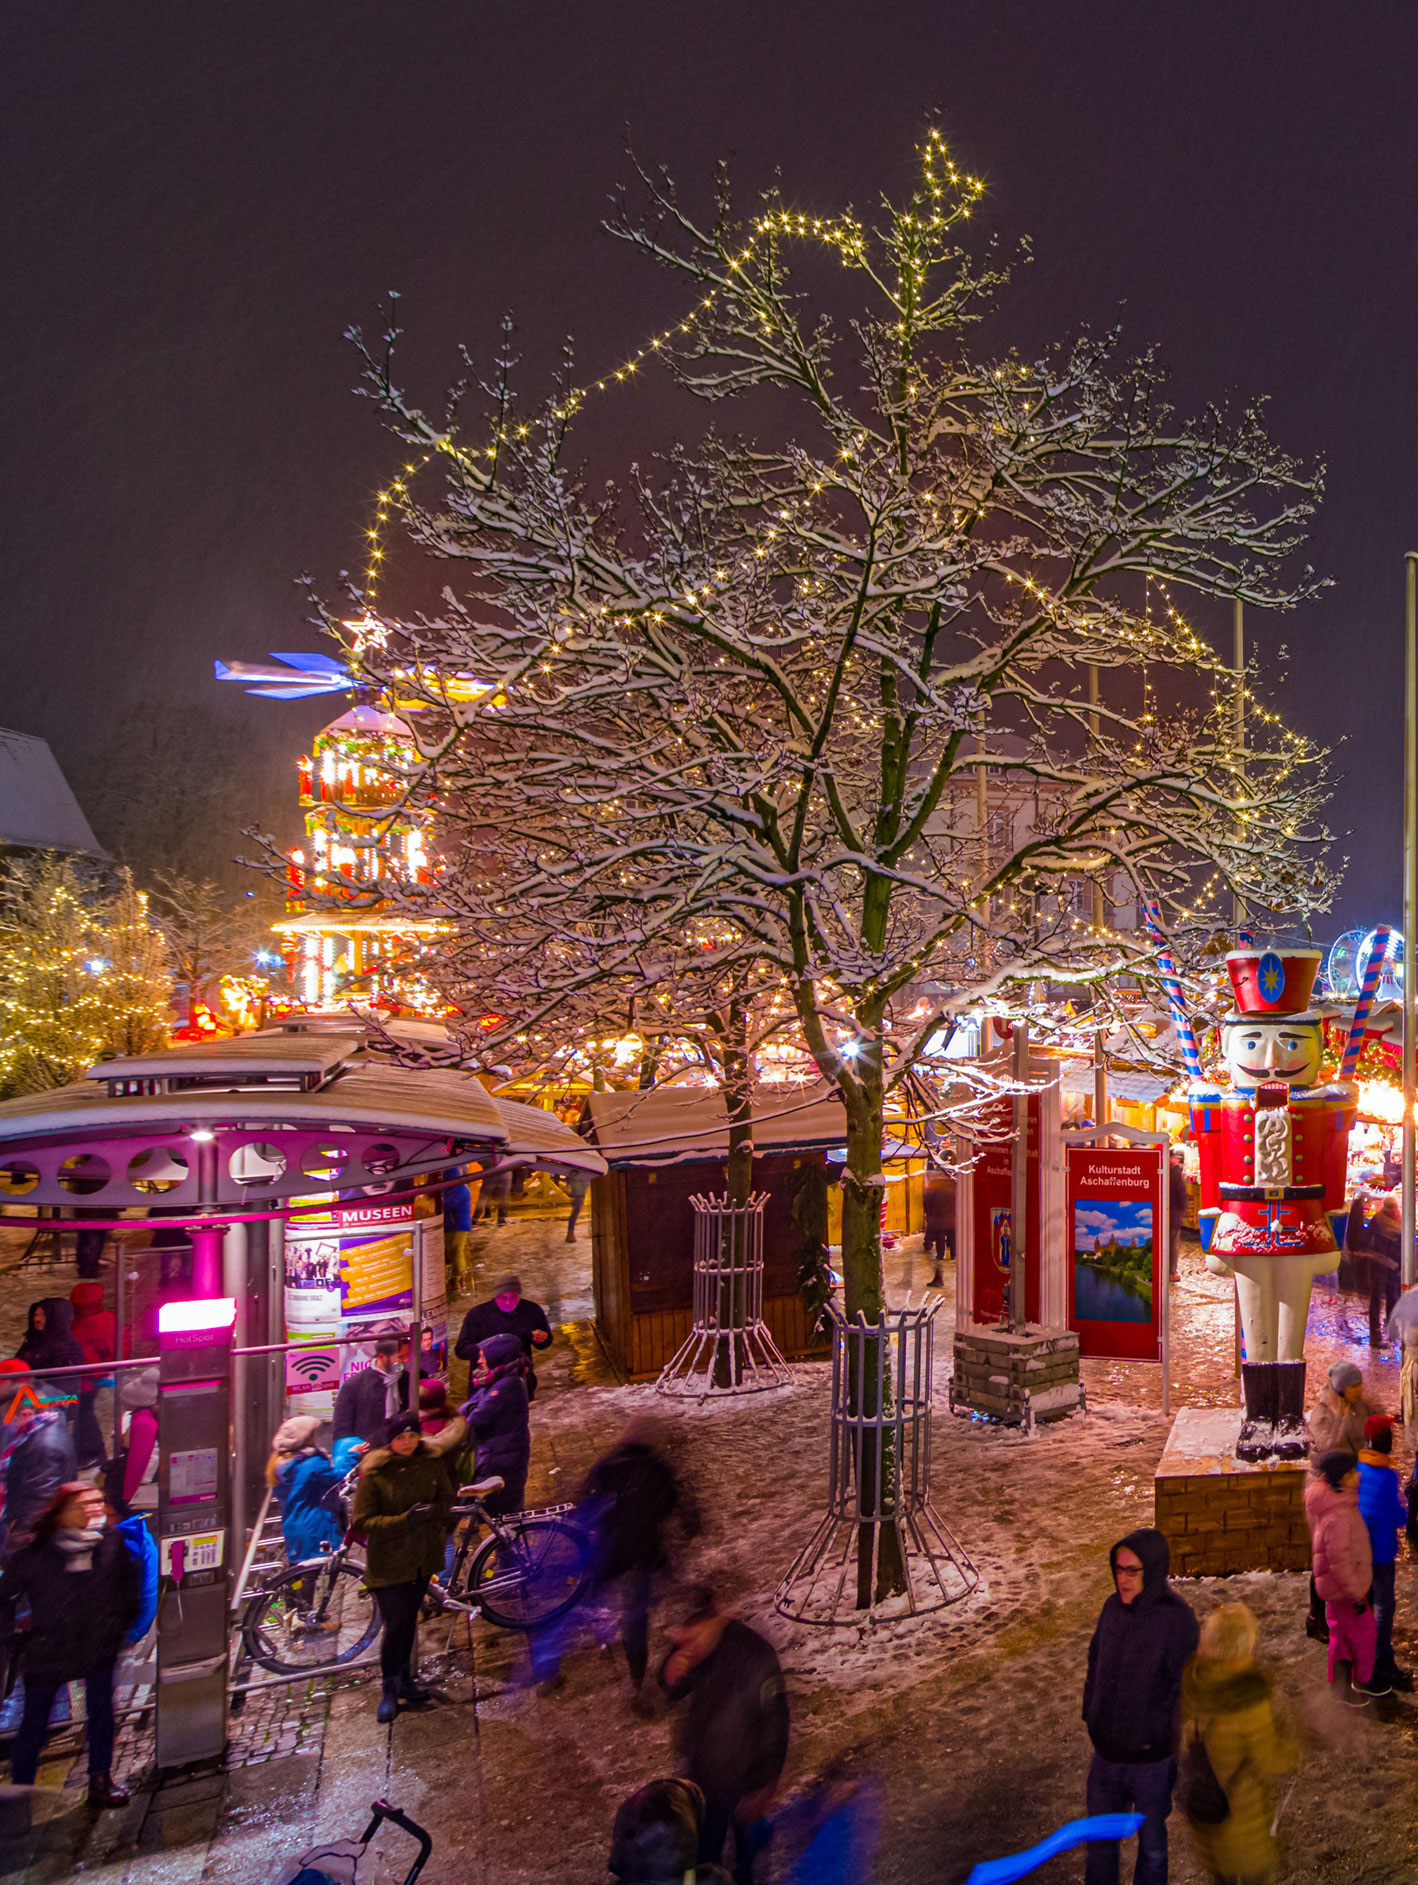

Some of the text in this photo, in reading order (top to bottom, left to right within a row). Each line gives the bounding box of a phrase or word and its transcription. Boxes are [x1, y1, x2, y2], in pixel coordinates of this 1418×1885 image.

[1088, 1165, 1141, 1175] Kulturstadt
[1080, 1176, 1150, 1189] Aschaffenburg
[342, 1206, 412, 1222] MUSEEN
